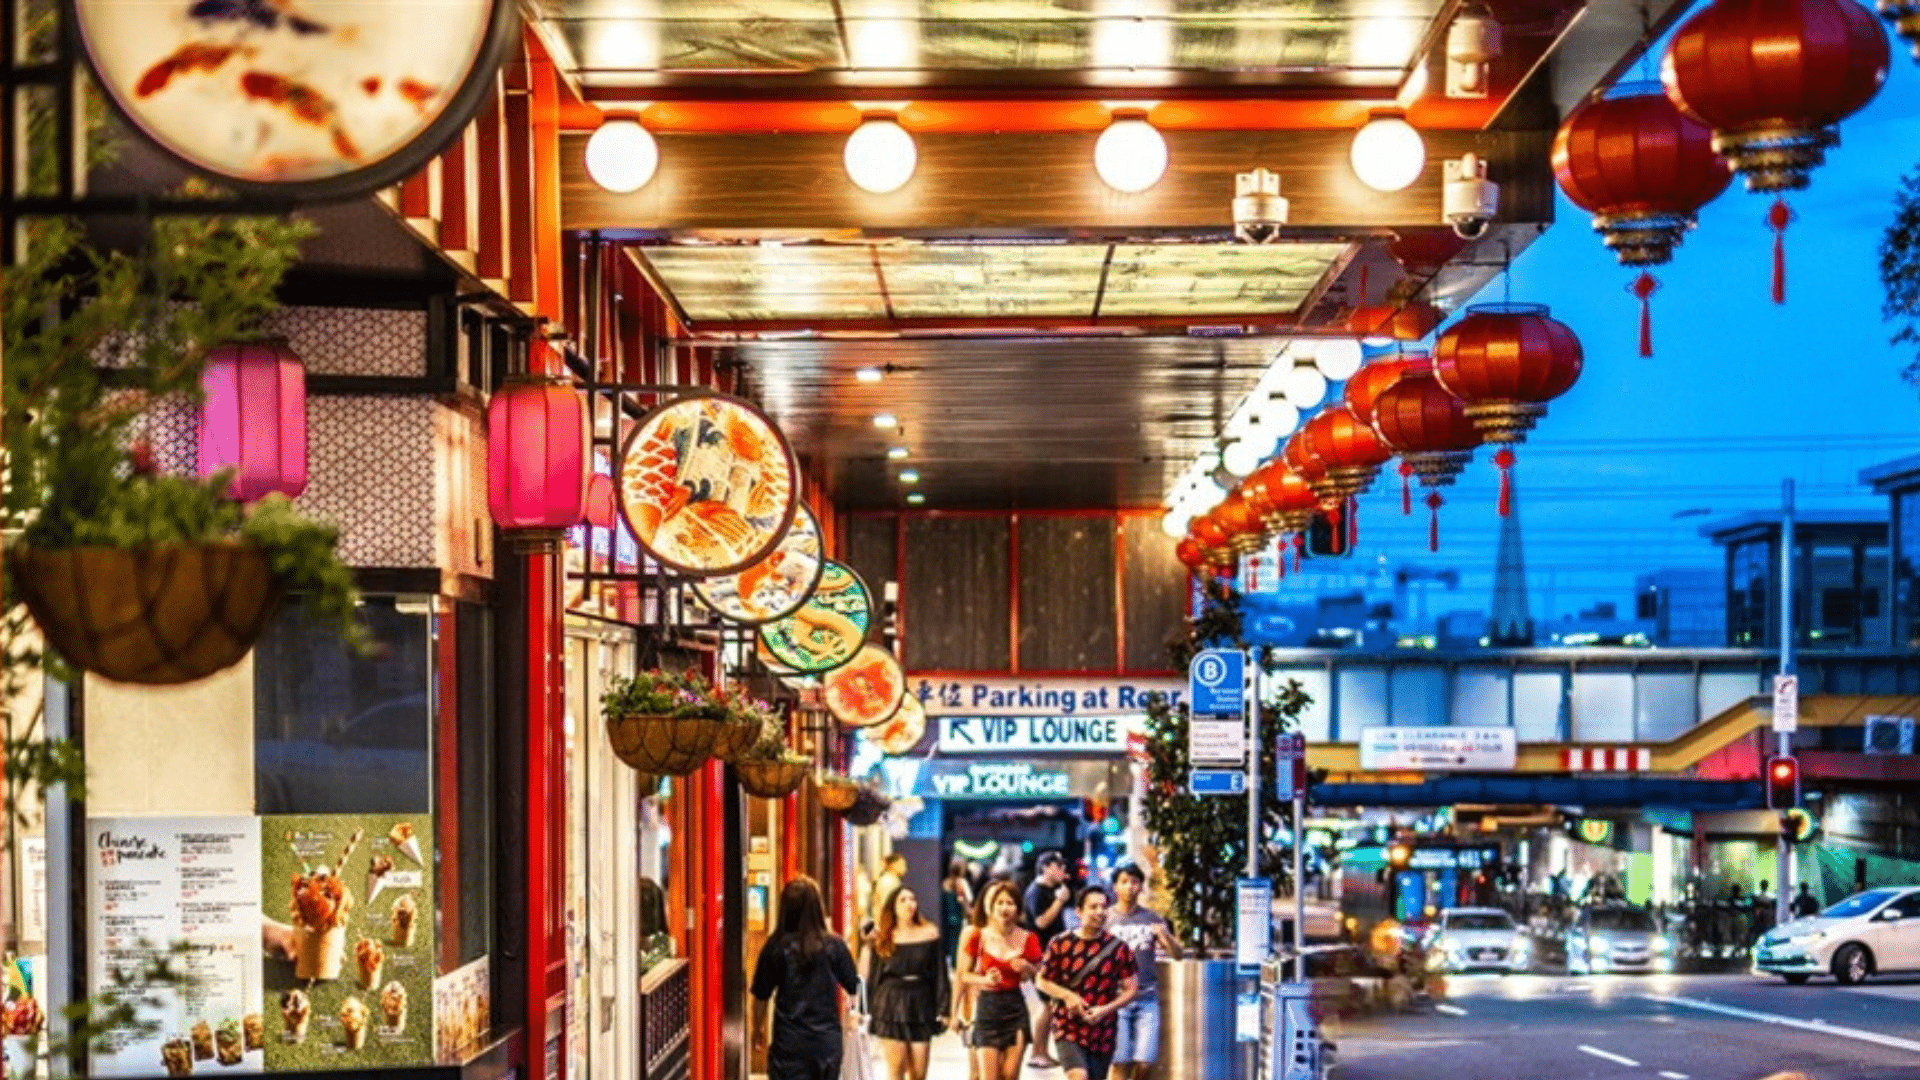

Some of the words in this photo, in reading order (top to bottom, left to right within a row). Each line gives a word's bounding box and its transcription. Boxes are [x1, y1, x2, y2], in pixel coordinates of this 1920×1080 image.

[1204, 661, 1218, 680] B
[972, 684, 1076, 713] Parking
[1083, 686, 1109, 708] at
[981, 717, 1017, 743] VIP
[1030, 717, 1117, 743] LOUNGE
[932, 774, 970, 795] VIP
[973, 773, 1069, 796] LOUNGE
